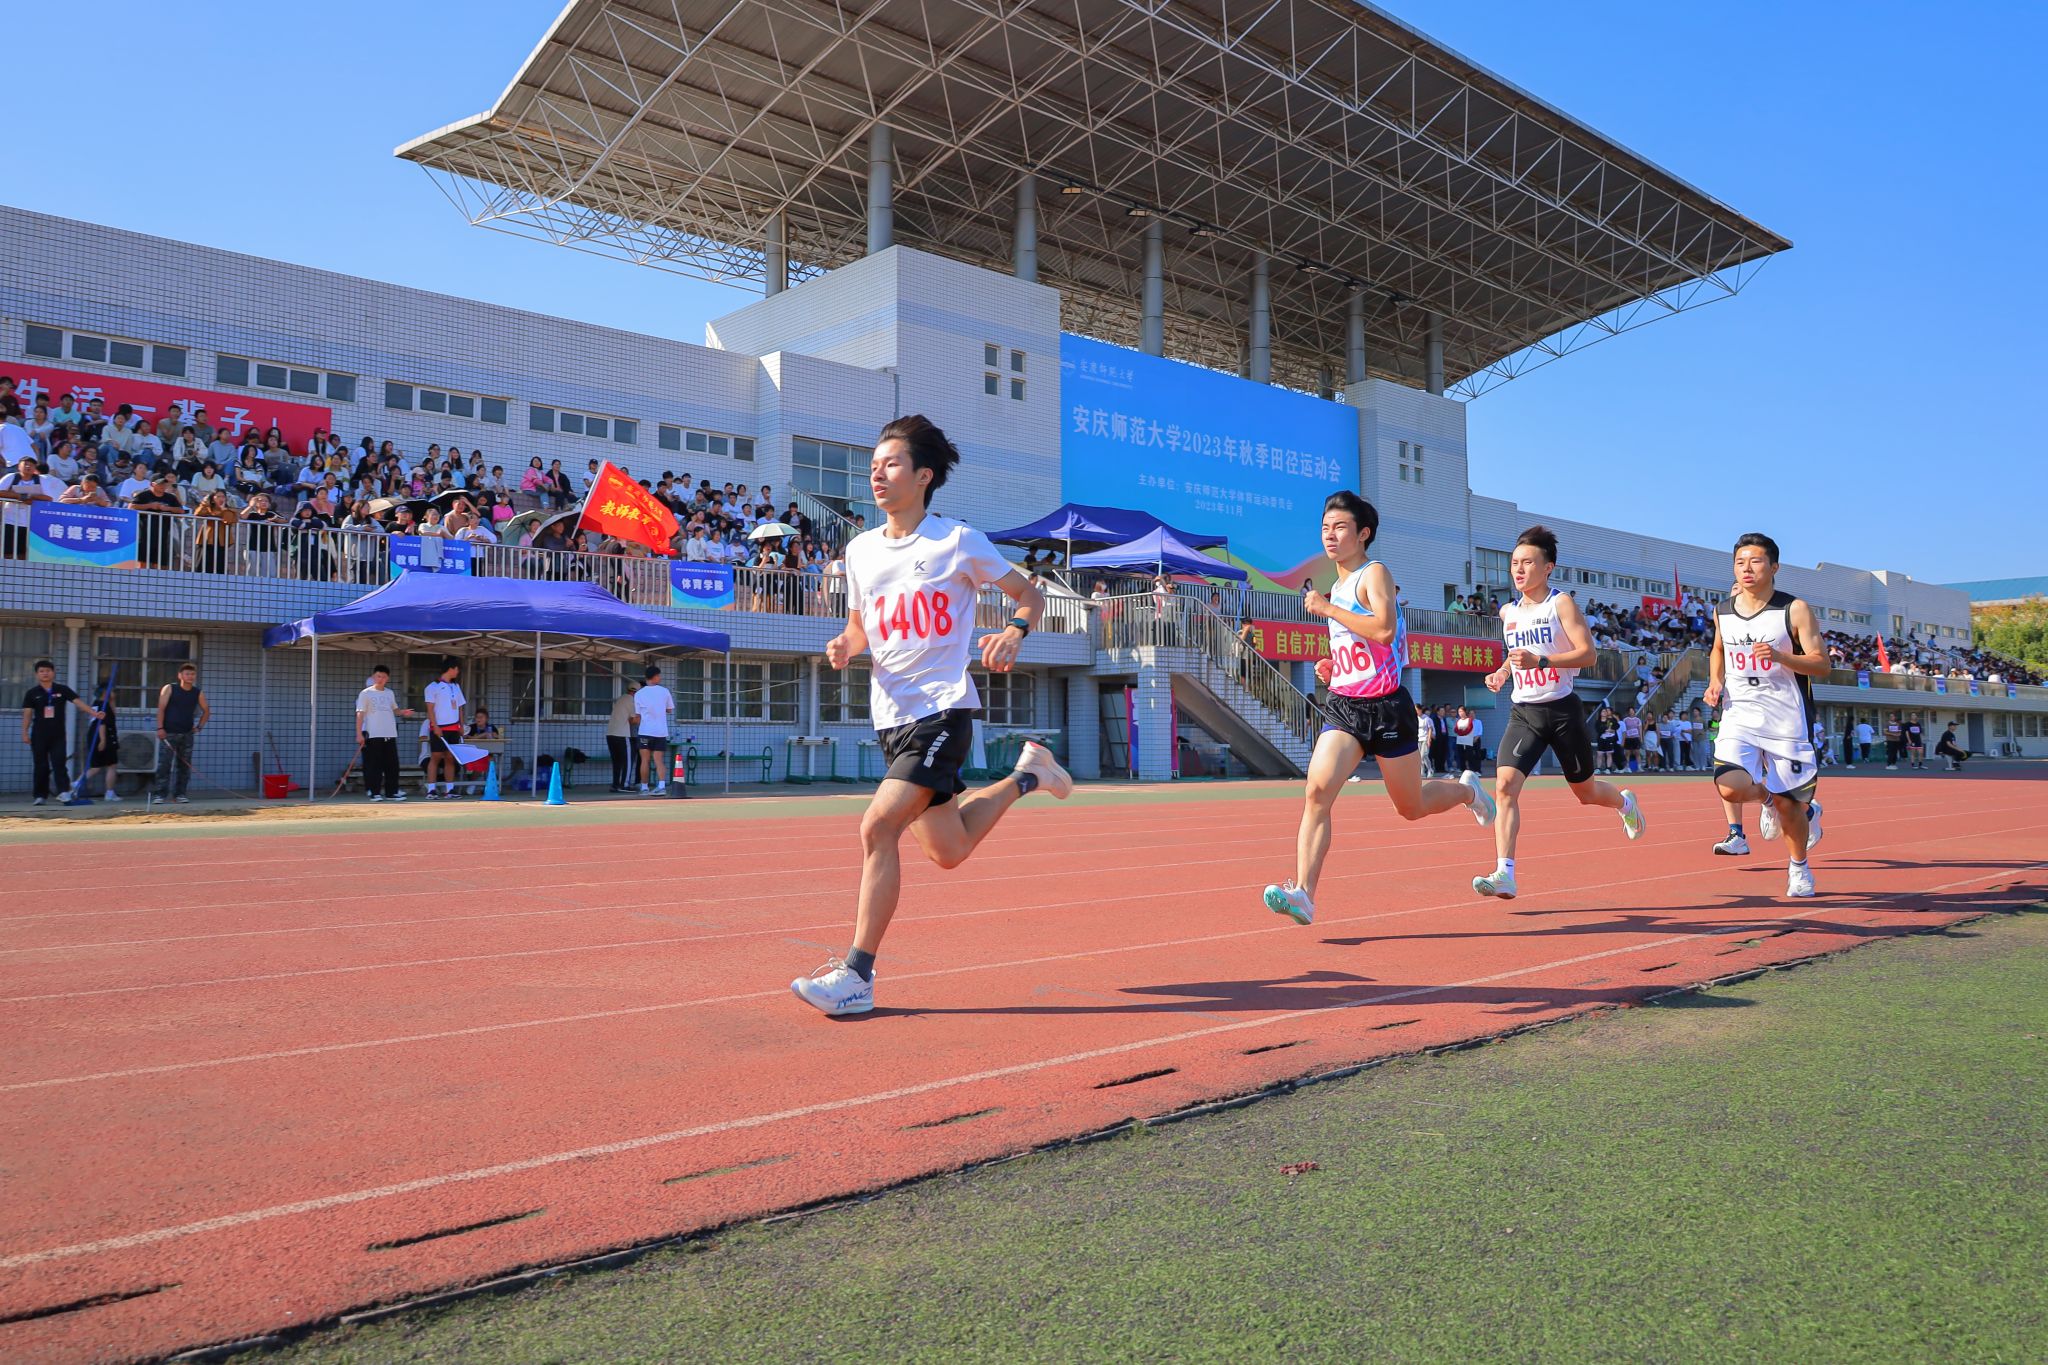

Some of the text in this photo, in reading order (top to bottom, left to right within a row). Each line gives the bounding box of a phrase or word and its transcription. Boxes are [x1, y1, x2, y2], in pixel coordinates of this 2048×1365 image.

[1072, 404, 1341, 483] 安庆师范大学2023年秋季田径运动会
[1195, 499, 1244, 517] 2023年11月
[681, 577, 724, 592] 体育学院
[874, 589, 954, 641] 1408
[1276, 630, 1331, 656] 自信开放
[1410, 641, 1444, 665] 求卓越
[1452, 644, 1494, 668] 共创未来
[1506, 626, 1553, 649] CHINA
[1515, 667, 1560, 690] 0404
